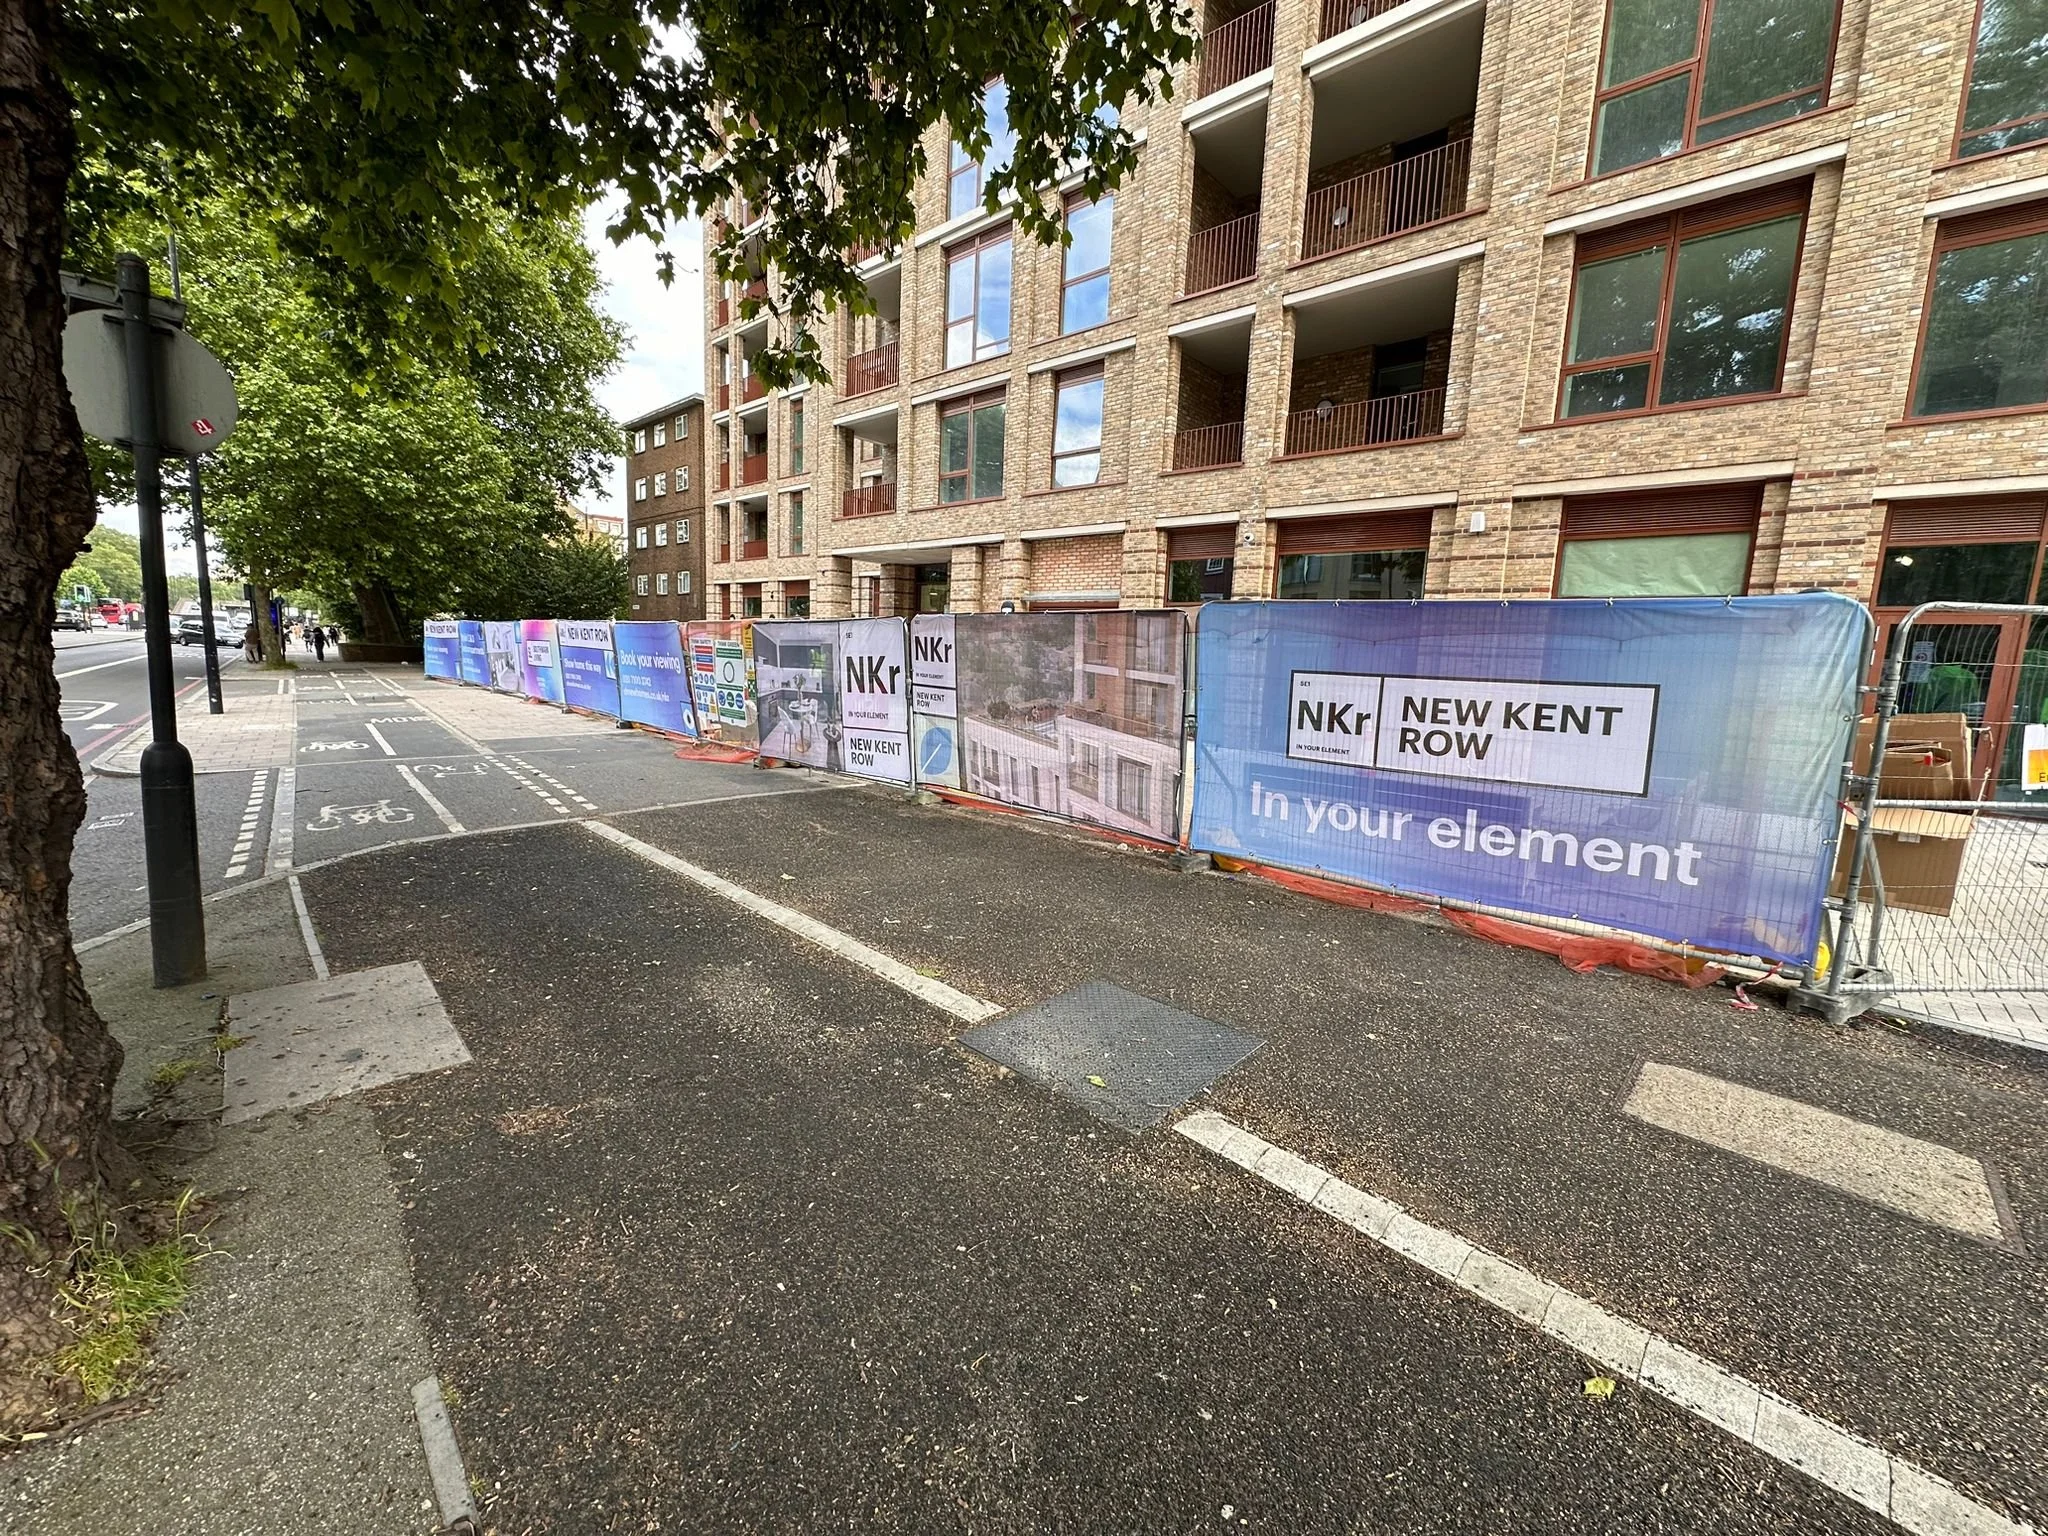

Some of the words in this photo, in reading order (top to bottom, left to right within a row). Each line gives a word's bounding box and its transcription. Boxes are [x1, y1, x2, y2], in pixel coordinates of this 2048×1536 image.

[567, 628, 580, 640] NEW
[580, 628, 594, 641] KENT
[594, 629, 609, 642] ROW
[914, 635, 952, 664] NKr
[620, 649, 637, 666] Book
[637, 654, 652, 670] your
[652, 651, 681, 675] viewing
[846, 655, 901, 695] NKr
[916, 691, 929, 700] NEW
[930, 693, 945, 702] KENT
[916, 700, 930, 708] ROW
[854, 711, 866, 719] YOUR
[867, 712, 889, 720] ELEMENT
[1297, 700, 1372, 736] NKr
[1401, 695, 1493, 728] NEW
[1502, 701, 1624, 736] KENT
[850, 738, 872, 752] NEW
[874, 740, 902, 756] KENT
[1304, 744, 1320, 752] YOUR
[1321, 746, 1351, 755] ELEMENT
[1398, 727, 1494, 760] ROW
[851, 752, 874, 767] ROW
[1250, 781, 1289, 821] In
[1302, 796, 1412, 841] your
[1427, 808, 1702, 886] element
